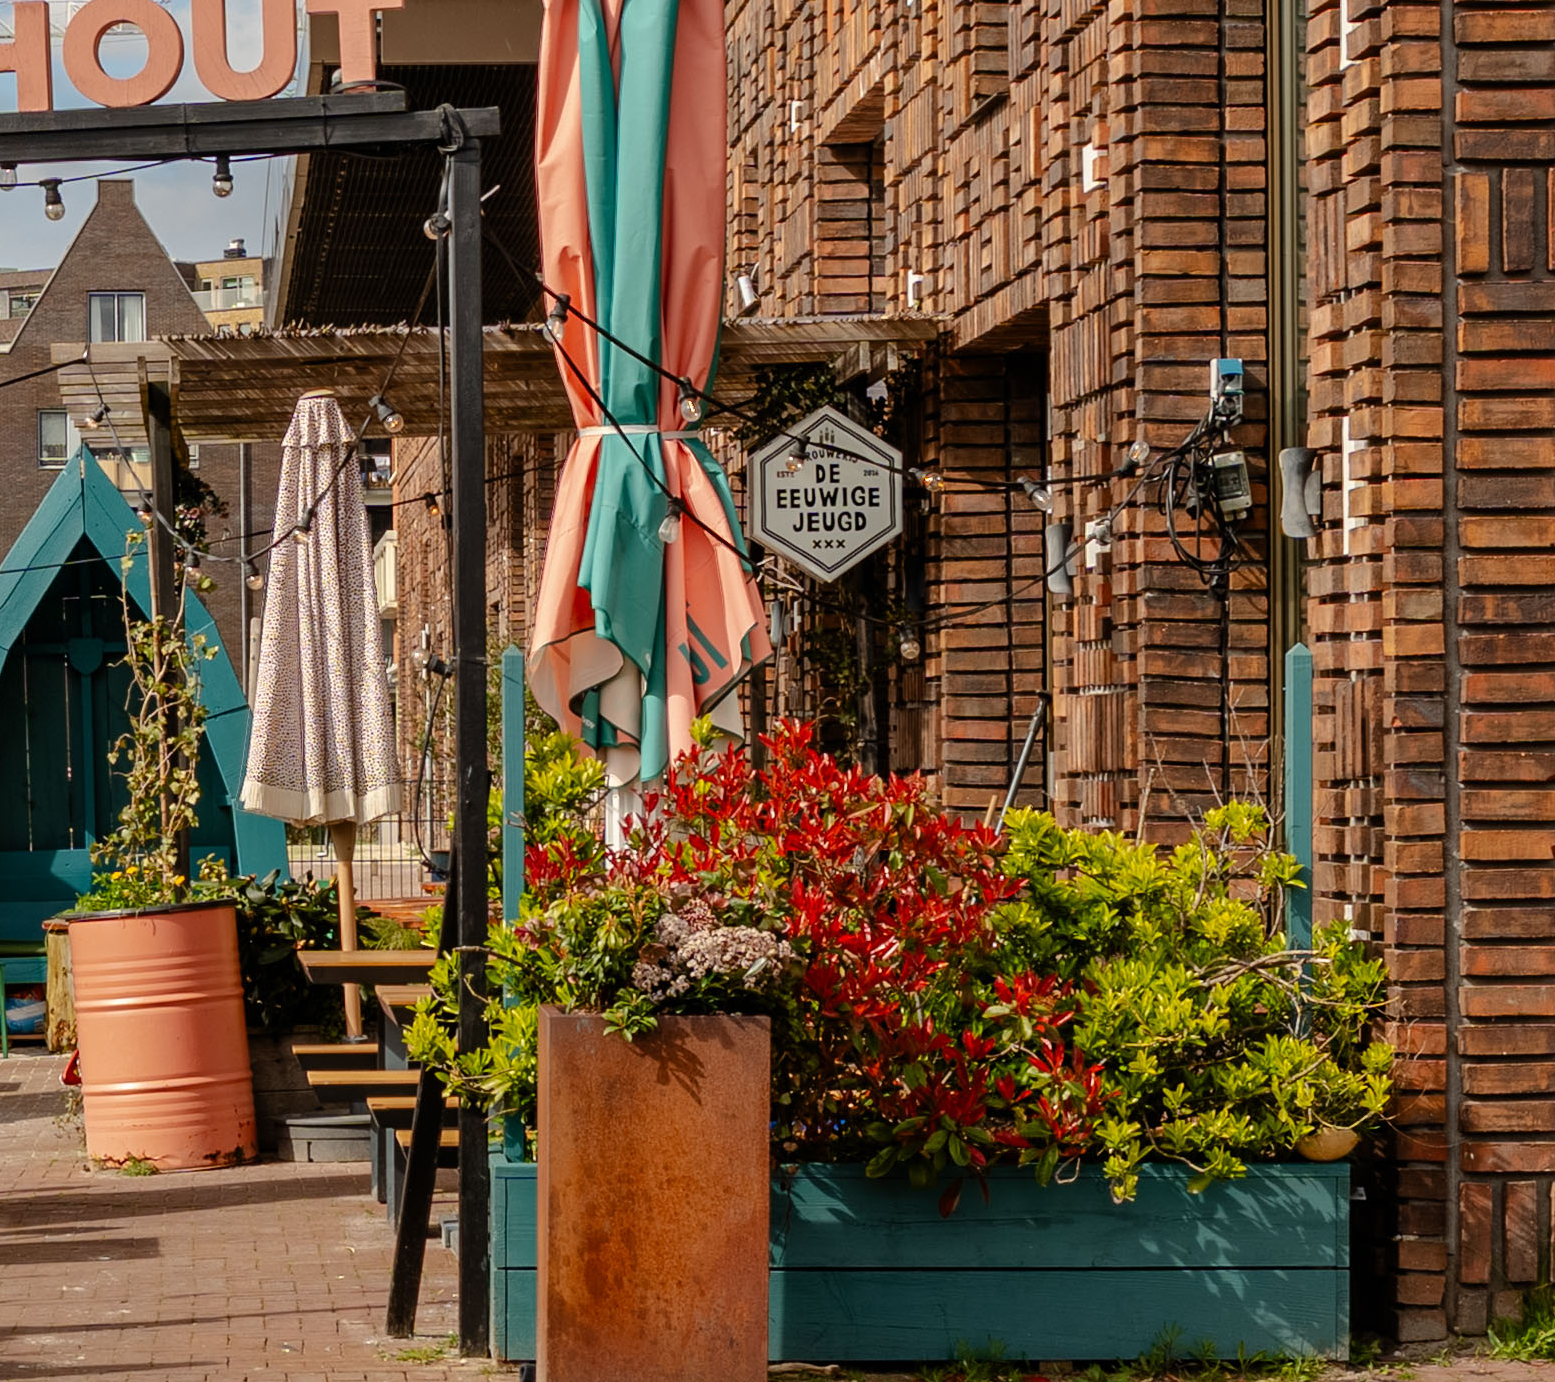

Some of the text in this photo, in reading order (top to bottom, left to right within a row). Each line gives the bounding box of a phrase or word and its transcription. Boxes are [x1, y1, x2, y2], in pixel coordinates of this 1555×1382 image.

[805, 449, 859, 463] ROUWERIJ
[815, 464, 840, 484] DE
[776, 486, 880, 509] EEUWIGE
[792, 511, 867, 532] JEUGD
